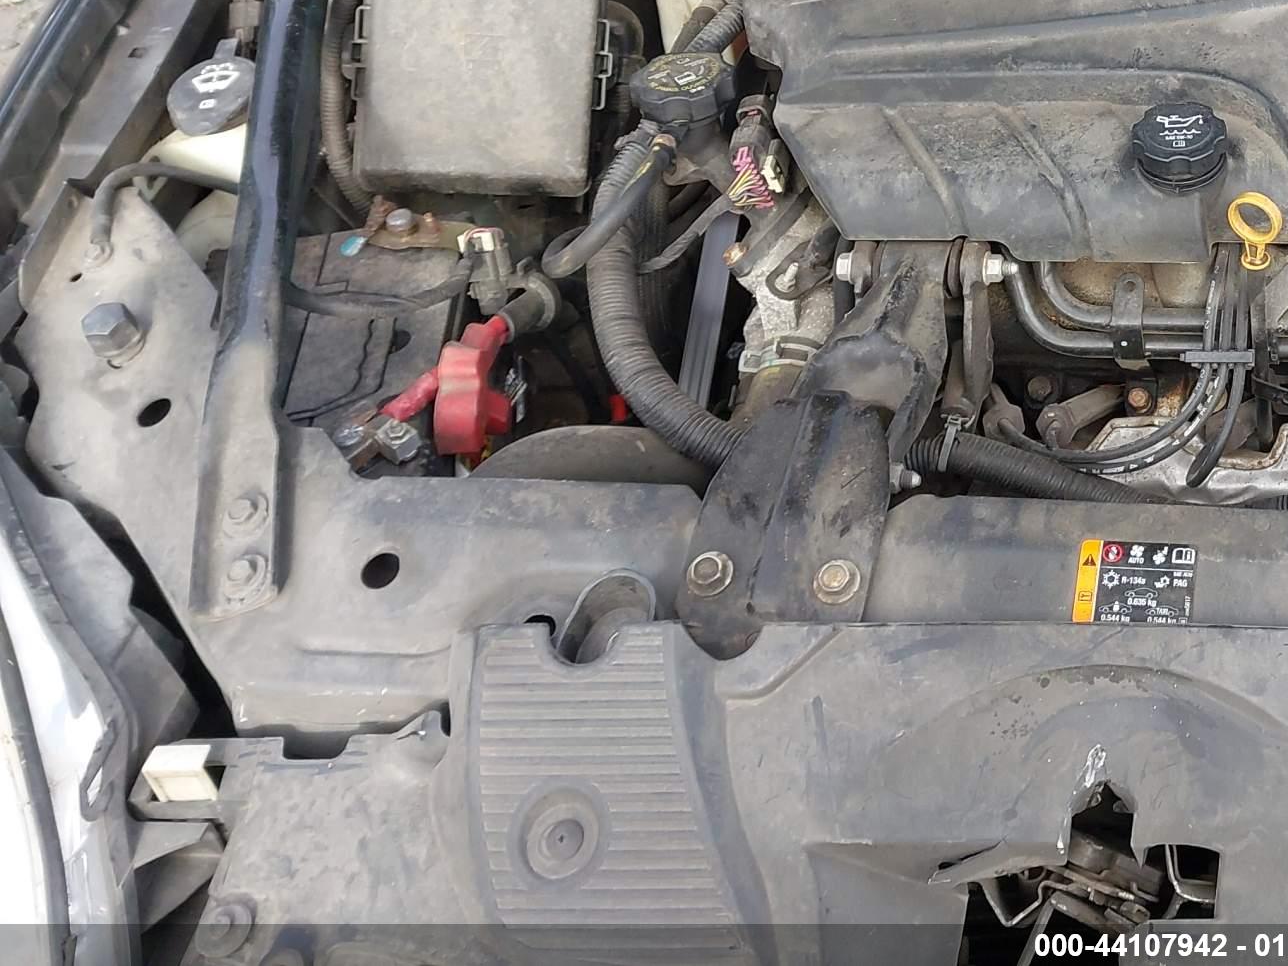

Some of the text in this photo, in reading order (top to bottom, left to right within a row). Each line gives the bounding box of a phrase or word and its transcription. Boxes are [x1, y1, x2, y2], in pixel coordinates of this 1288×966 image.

[1121, 576, 1146, 585] R-134a
[1173, 579, 1188, 587] PAG
[1127, 598, 1157, 608] 0.635 kg
[1100, 614, 1131, 623] 0.544 kg
